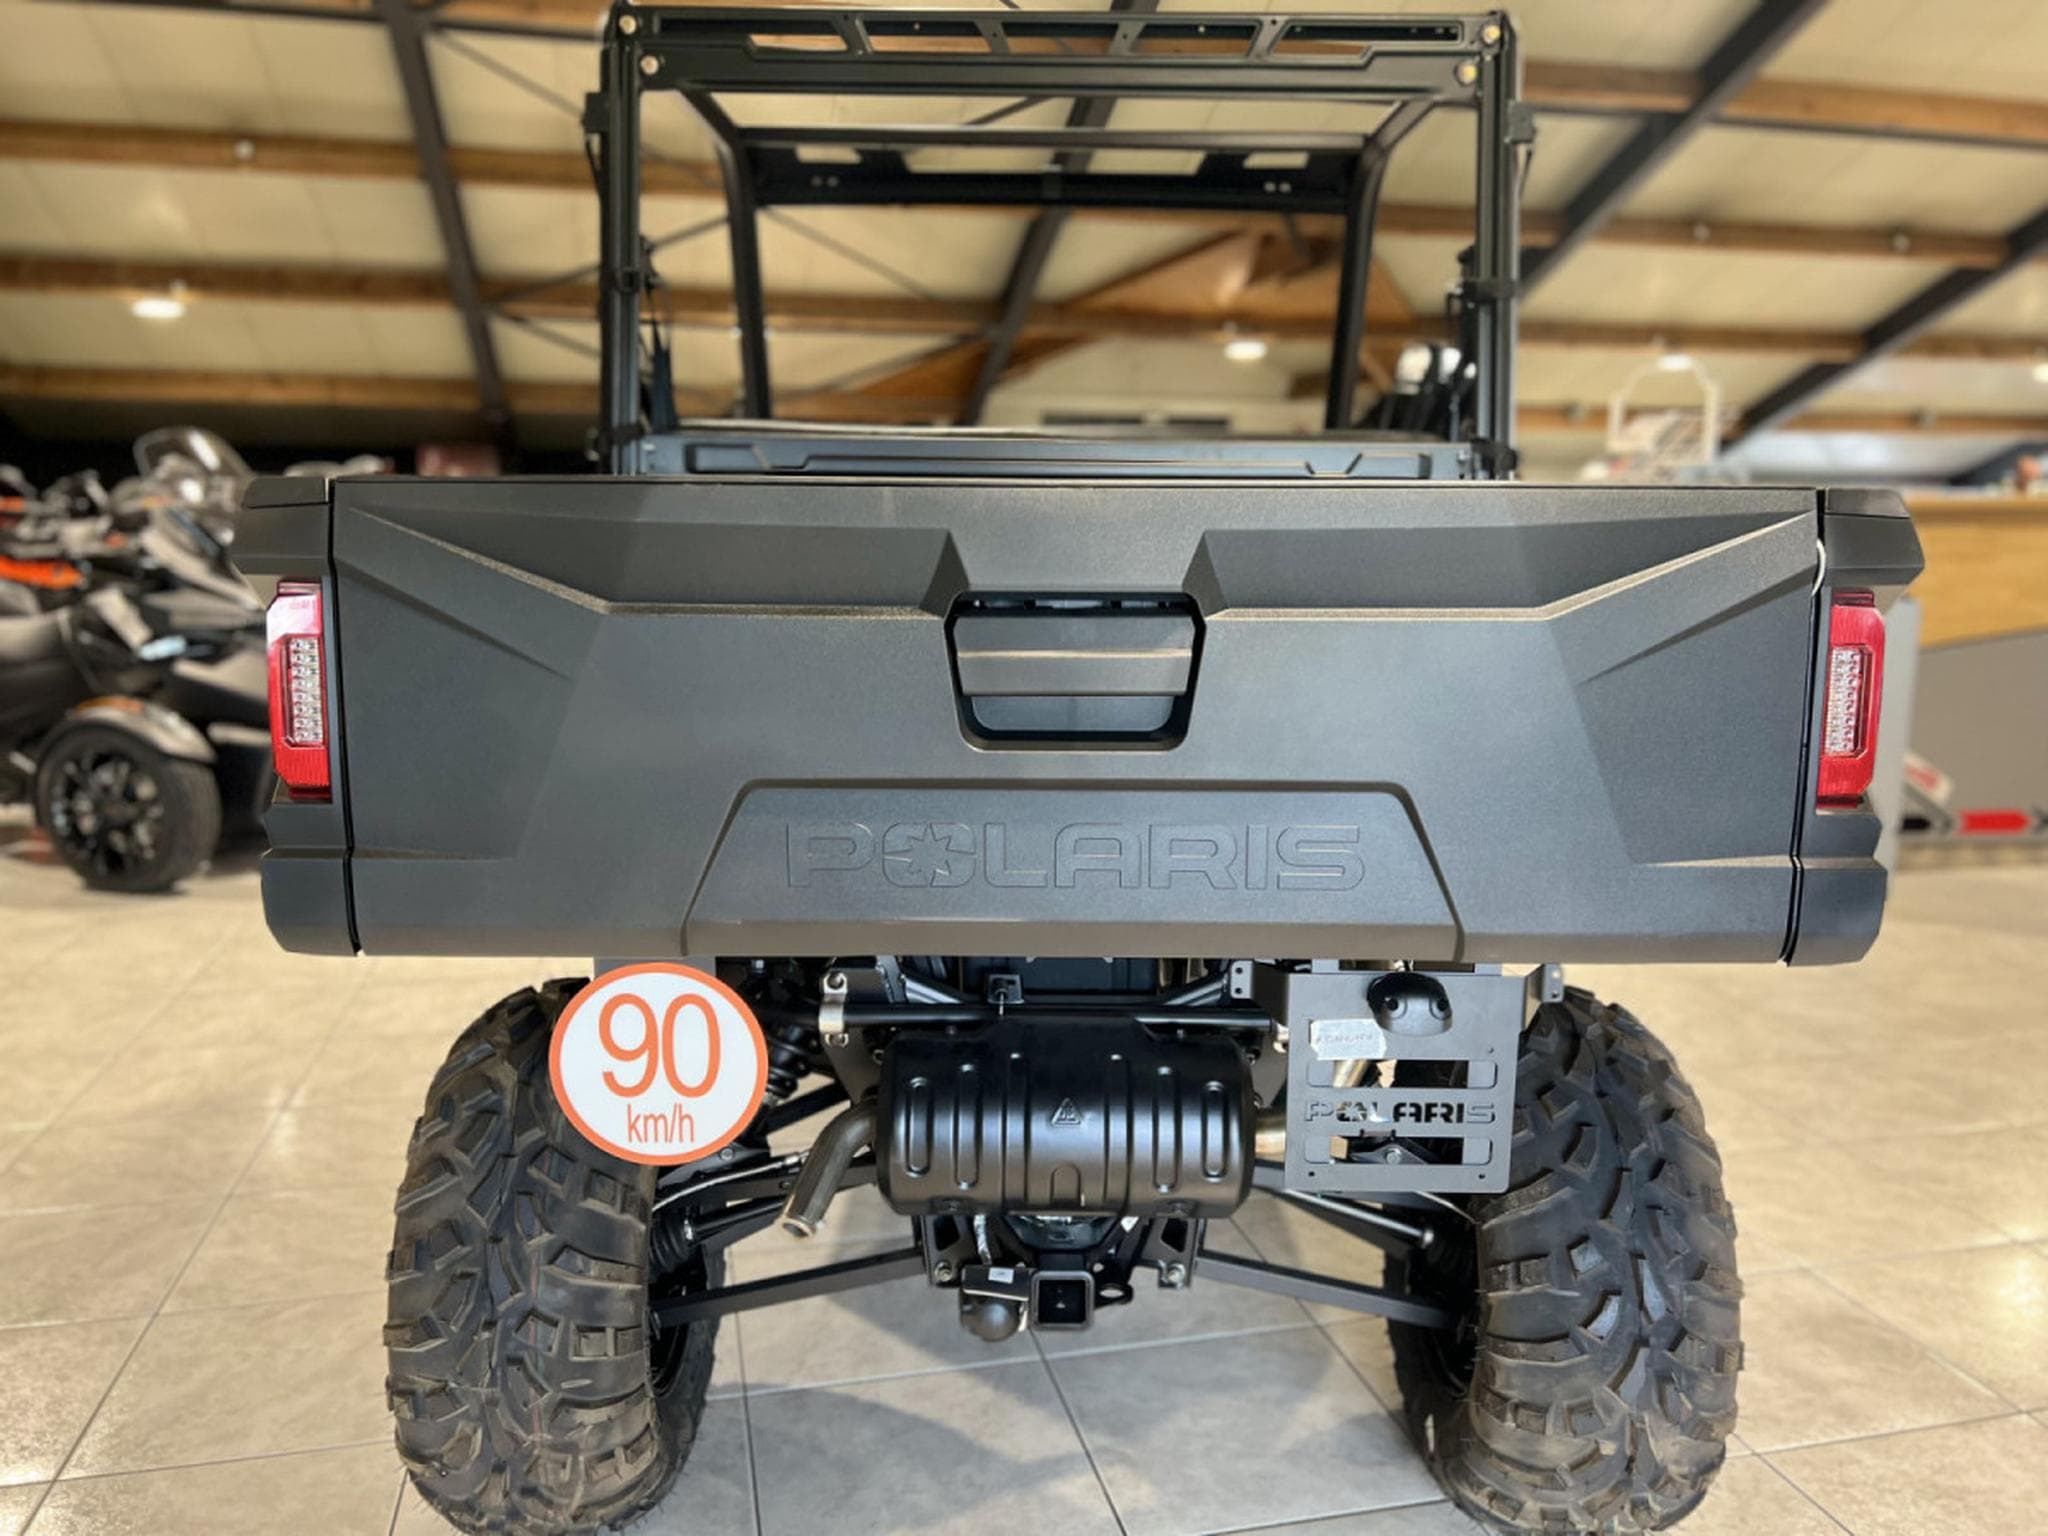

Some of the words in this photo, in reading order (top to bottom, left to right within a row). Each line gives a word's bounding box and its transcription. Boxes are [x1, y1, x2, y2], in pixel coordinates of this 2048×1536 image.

[787, 822, 1365, 891] POLARIS
[598, 992, 721, 1098] 90
[626, 1103, 695, 1144] km/h
[1304, 1101, 1496, 1124] POLARIS
